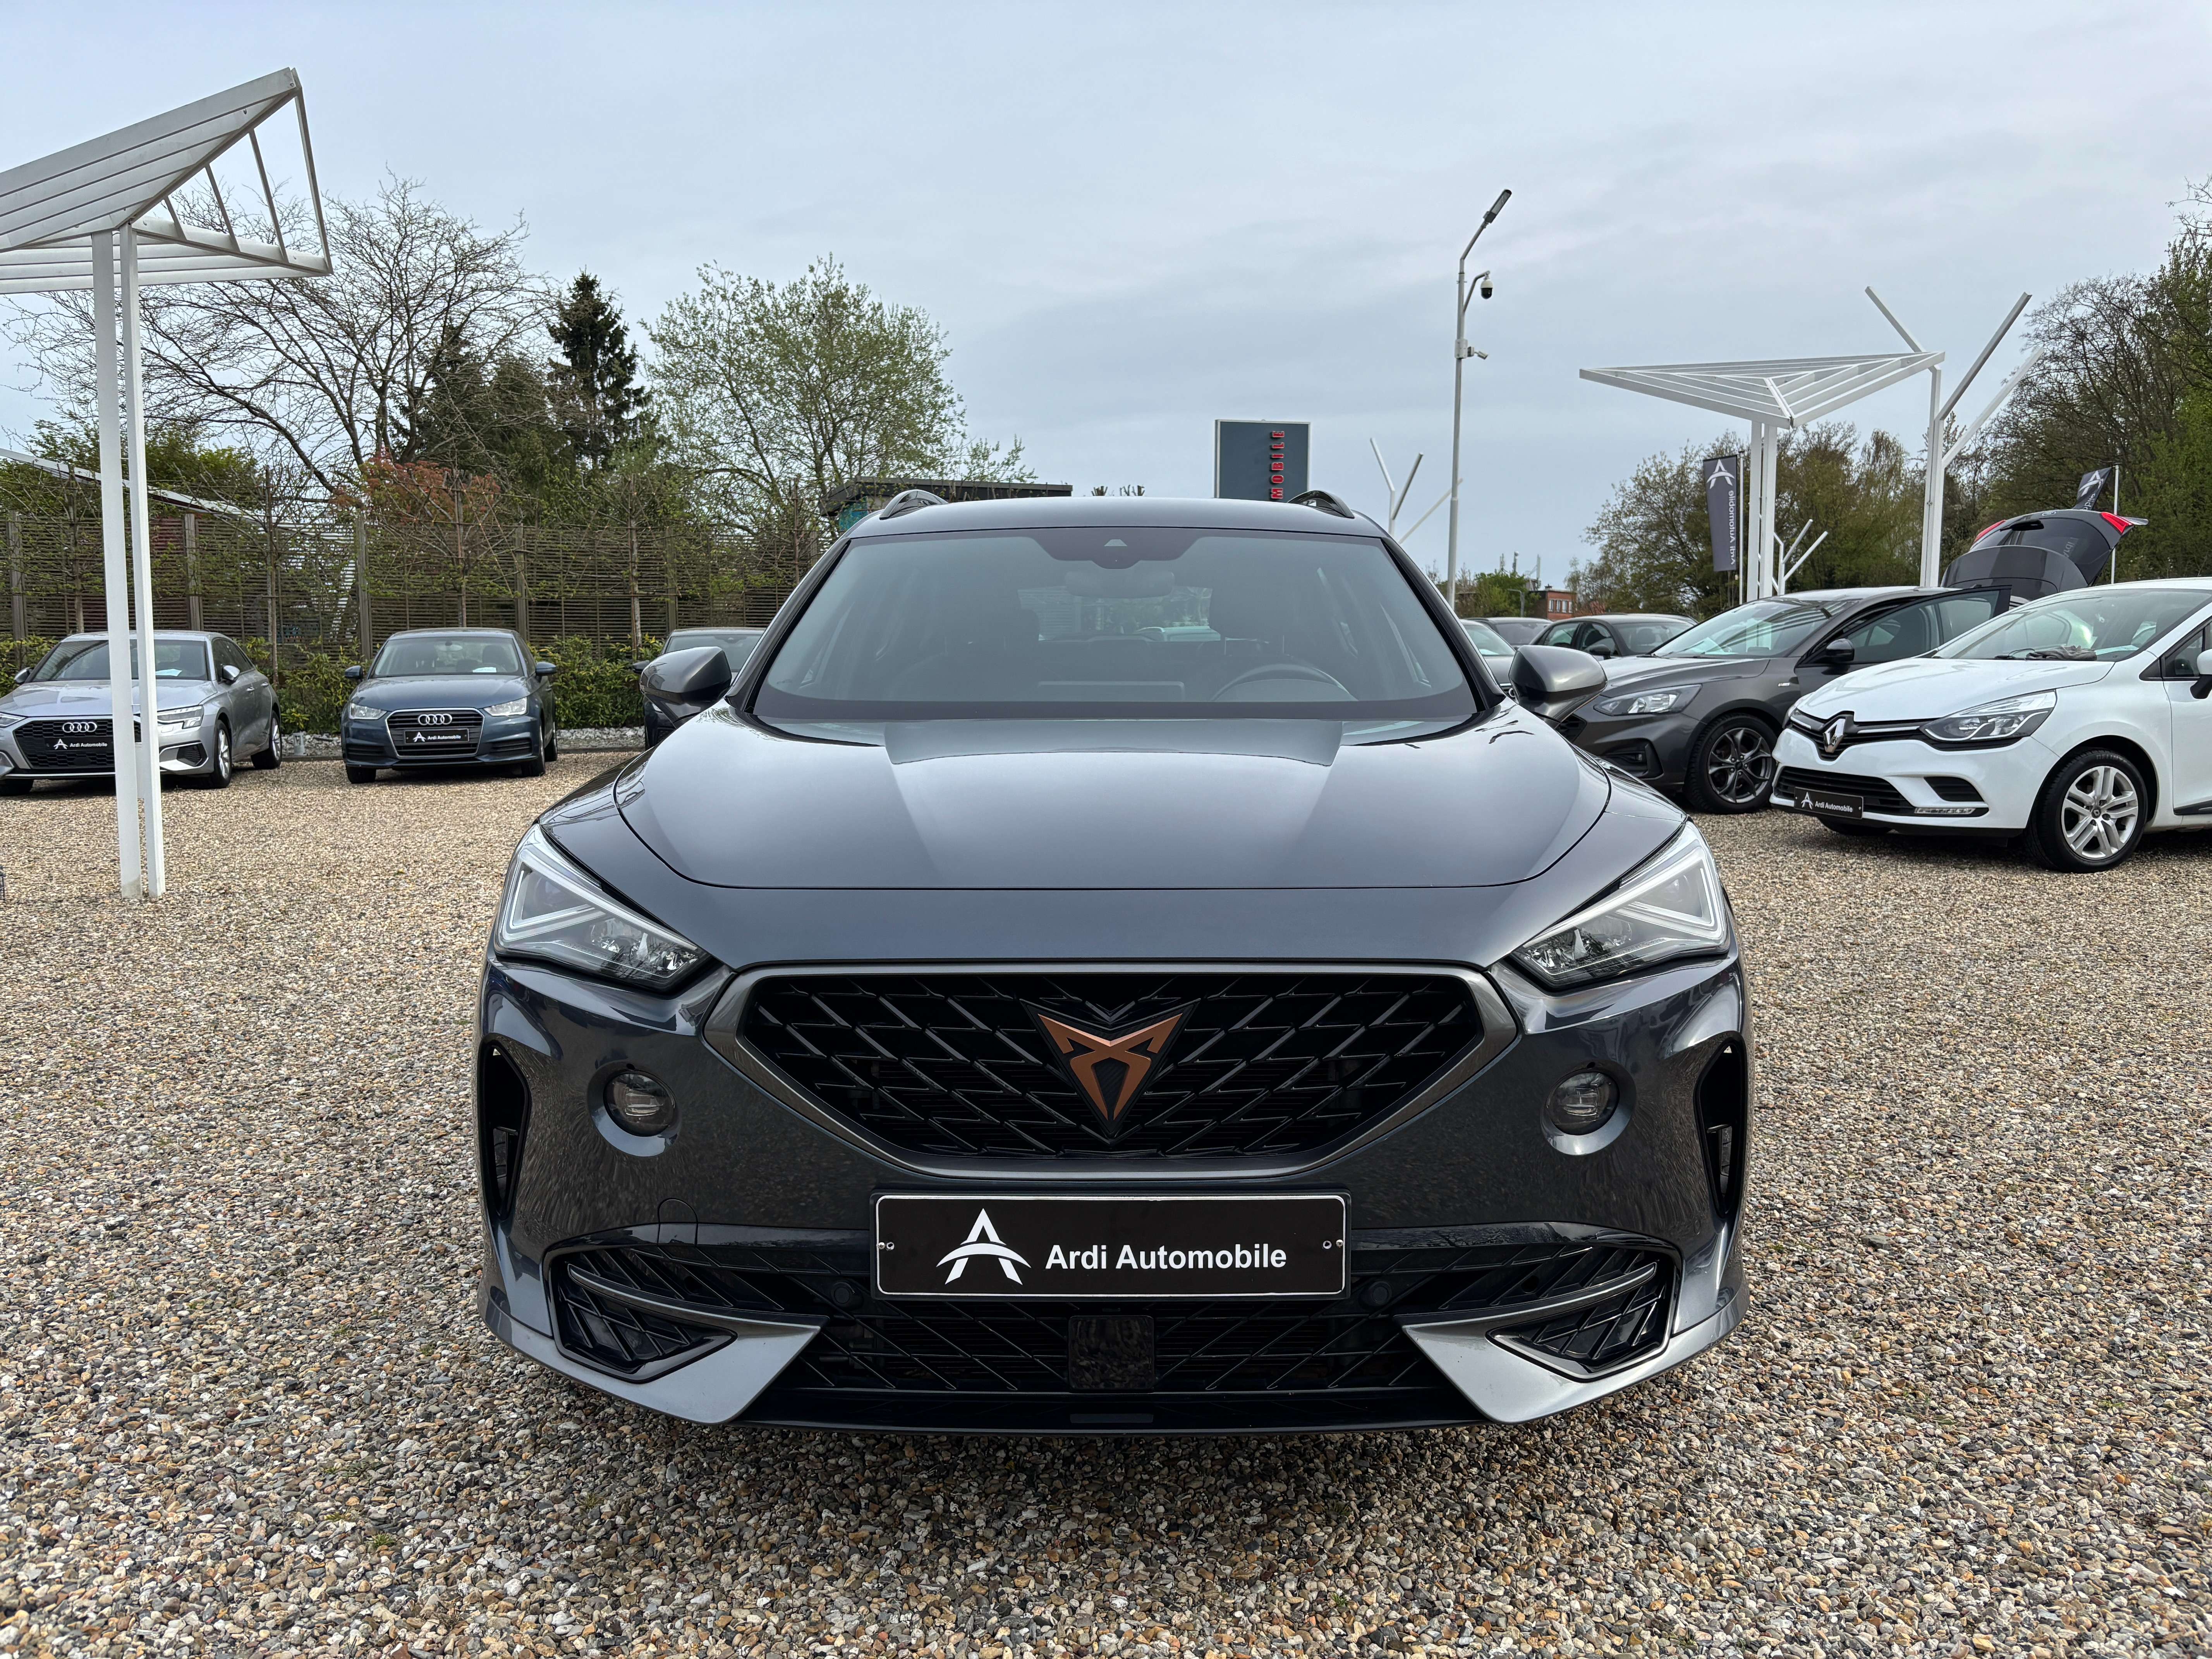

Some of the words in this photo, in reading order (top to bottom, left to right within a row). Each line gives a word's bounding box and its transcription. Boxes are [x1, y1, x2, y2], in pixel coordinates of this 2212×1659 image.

[1271, 431, 1285, 499] MOBILE
[1825, 802, 1853, 812] Automobile
[1046, 1245, 1107, 1269] Ardi
[1116, 1243, 1286, 1269] Automobile
